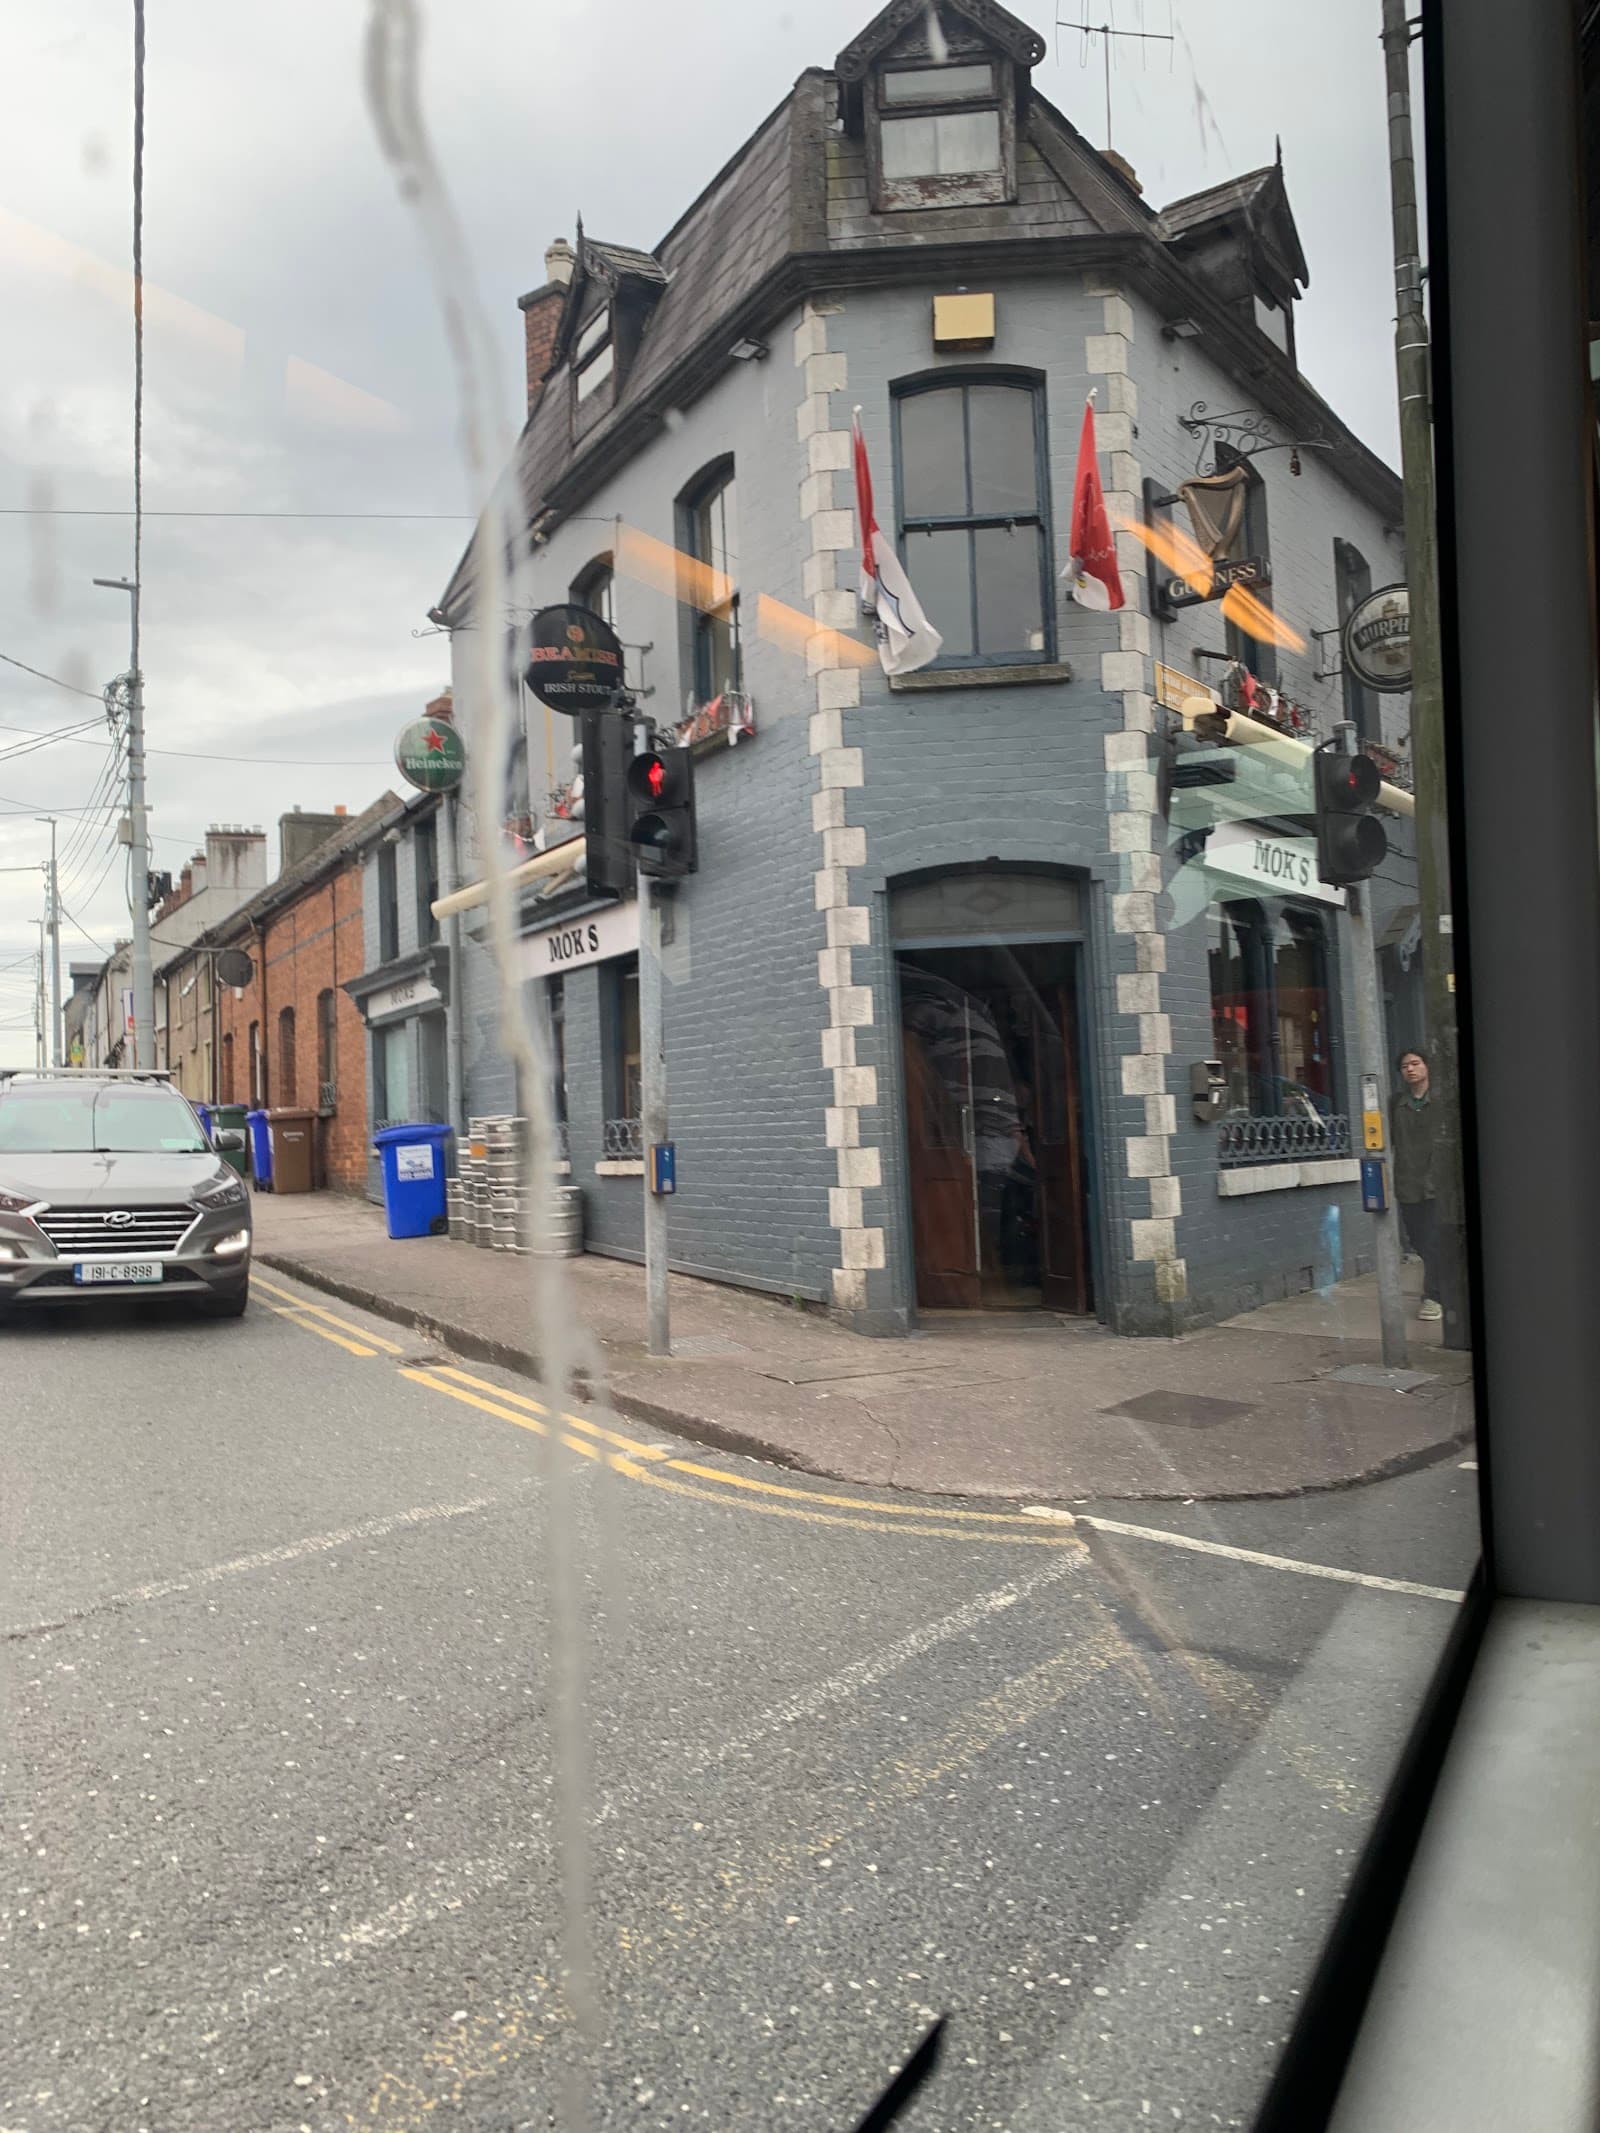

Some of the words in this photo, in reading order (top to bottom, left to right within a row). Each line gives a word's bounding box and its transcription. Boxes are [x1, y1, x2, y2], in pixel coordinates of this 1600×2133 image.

[1168, 562, 1257, 598] GUNESS
[1359, 617, 1409, 643] MURPH
[544, 683, 576, 693] IRISH
[406, 756, 463, 770] Heineken
[91, 1264, 153, 1279] 191-C-8998
